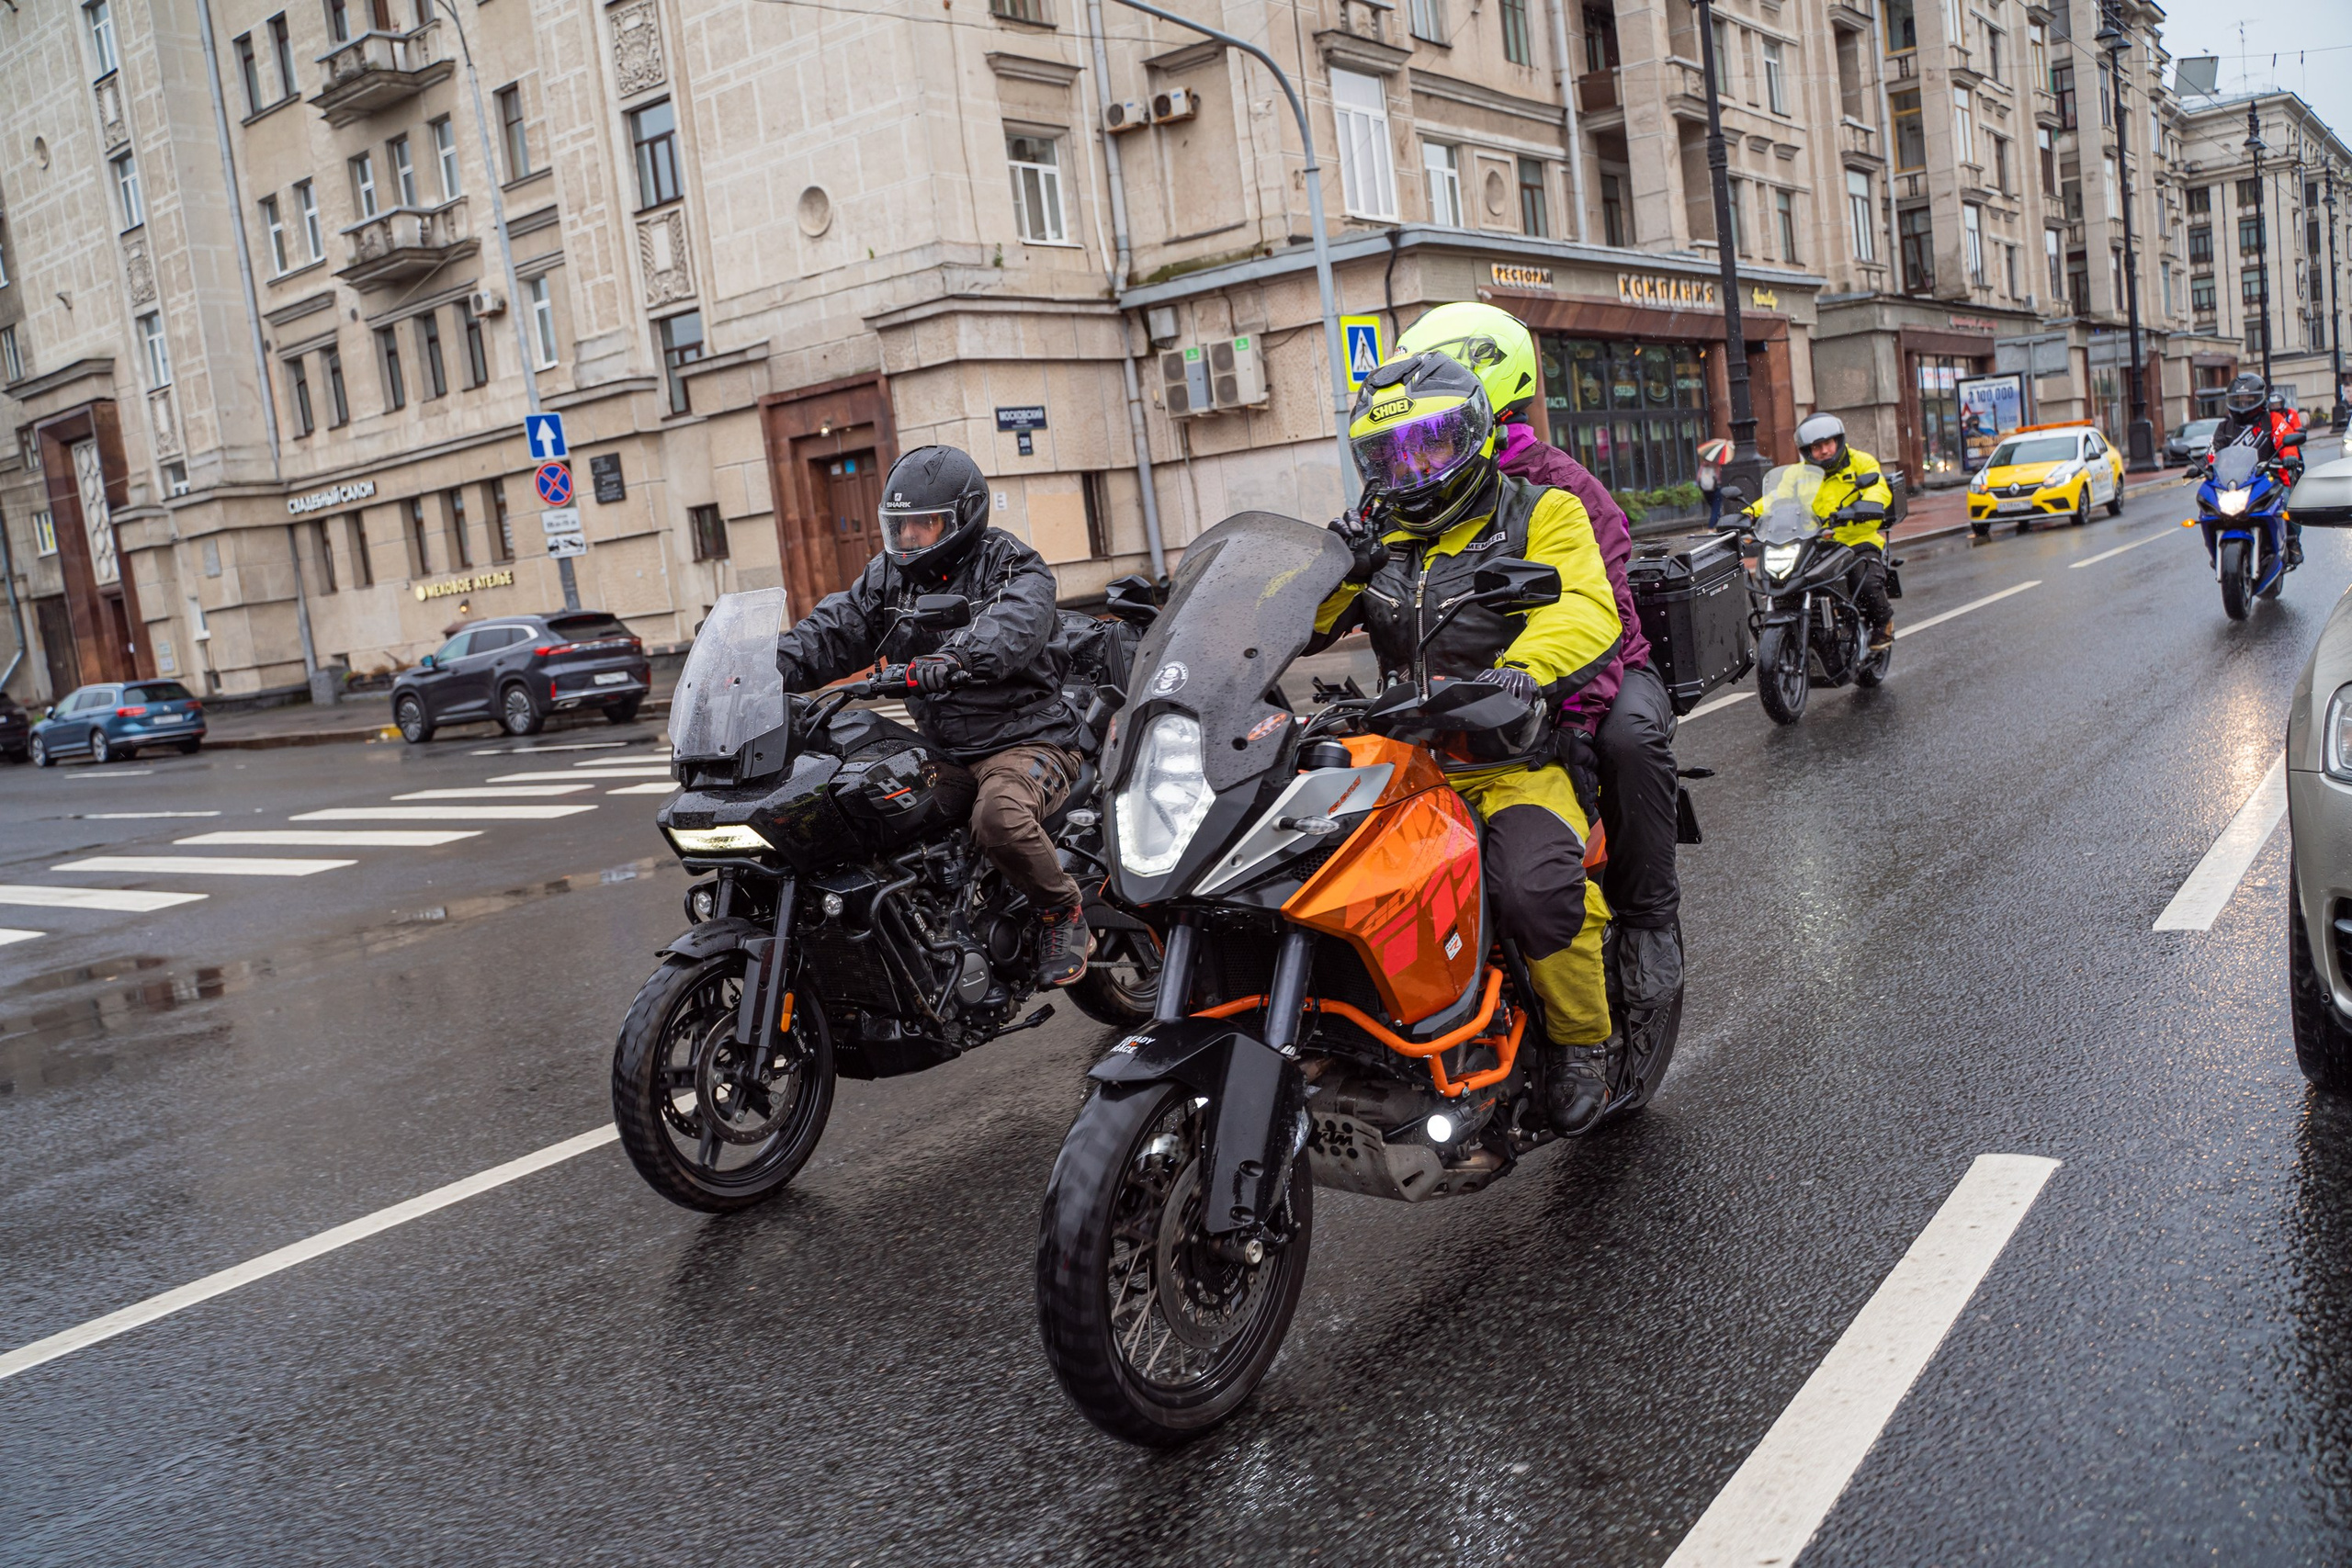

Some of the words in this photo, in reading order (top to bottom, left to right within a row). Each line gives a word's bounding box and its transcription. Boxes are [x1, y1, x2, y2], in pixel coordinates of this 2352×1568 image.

[1491, 264, 1554, 288] РЕСТОРАН
[1618, 274, 1715, 310] КОМПАНИЯ
[1976, 389, 1993, 402] 100
[1996, 387, 2013, 400] 000
[1373, 400, 1408, 421] SHOEI
[287, 486, 340, 514] СВАДЕБНЫЙ
[340, 480, 375, 502] САЛОН
[474, 570, 513, 590] АТЕЛЬЕ
[1110, 1044, 1138, 1055] RACE
[1123, 1035, 1157, 1045] READY
